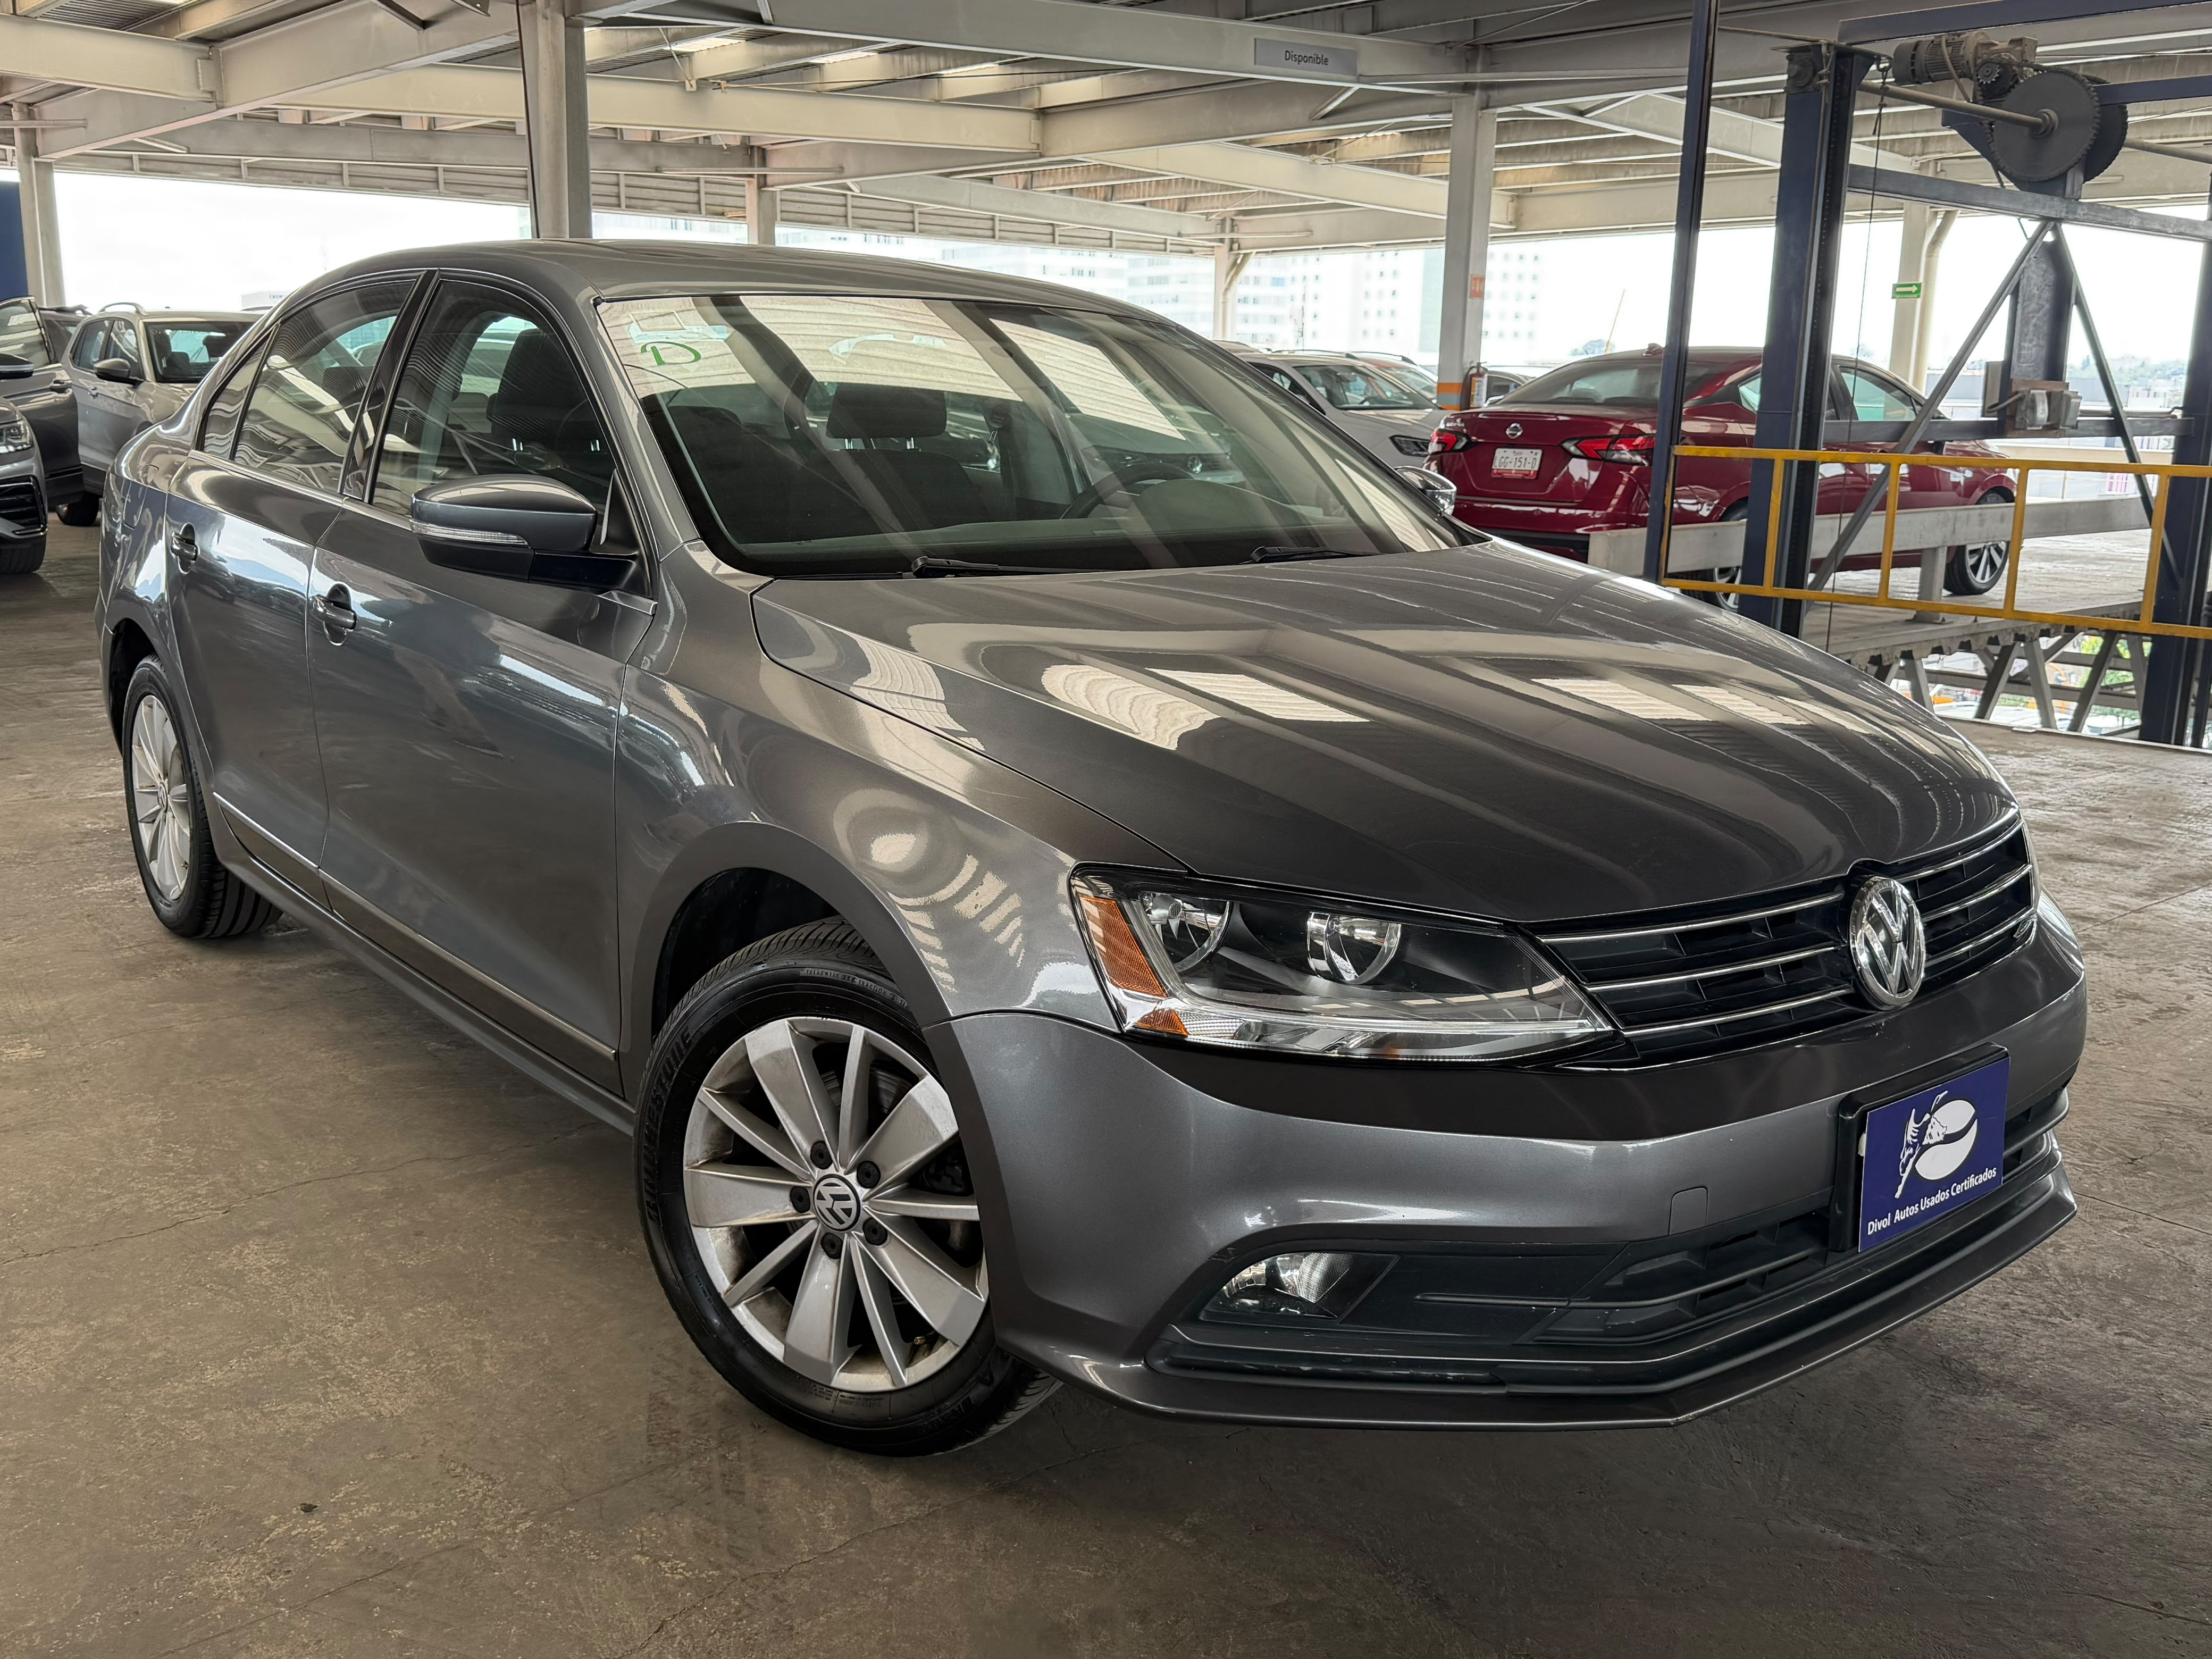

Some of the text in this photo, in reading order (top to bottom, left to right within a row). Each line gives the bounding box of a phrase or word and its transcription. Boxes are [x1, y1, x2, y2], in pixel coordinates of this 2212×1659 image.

[1285, 50, 1329, 65] Disponible
[1867, 1167, 1997, 1235] Divol Autos Usados Certificados
